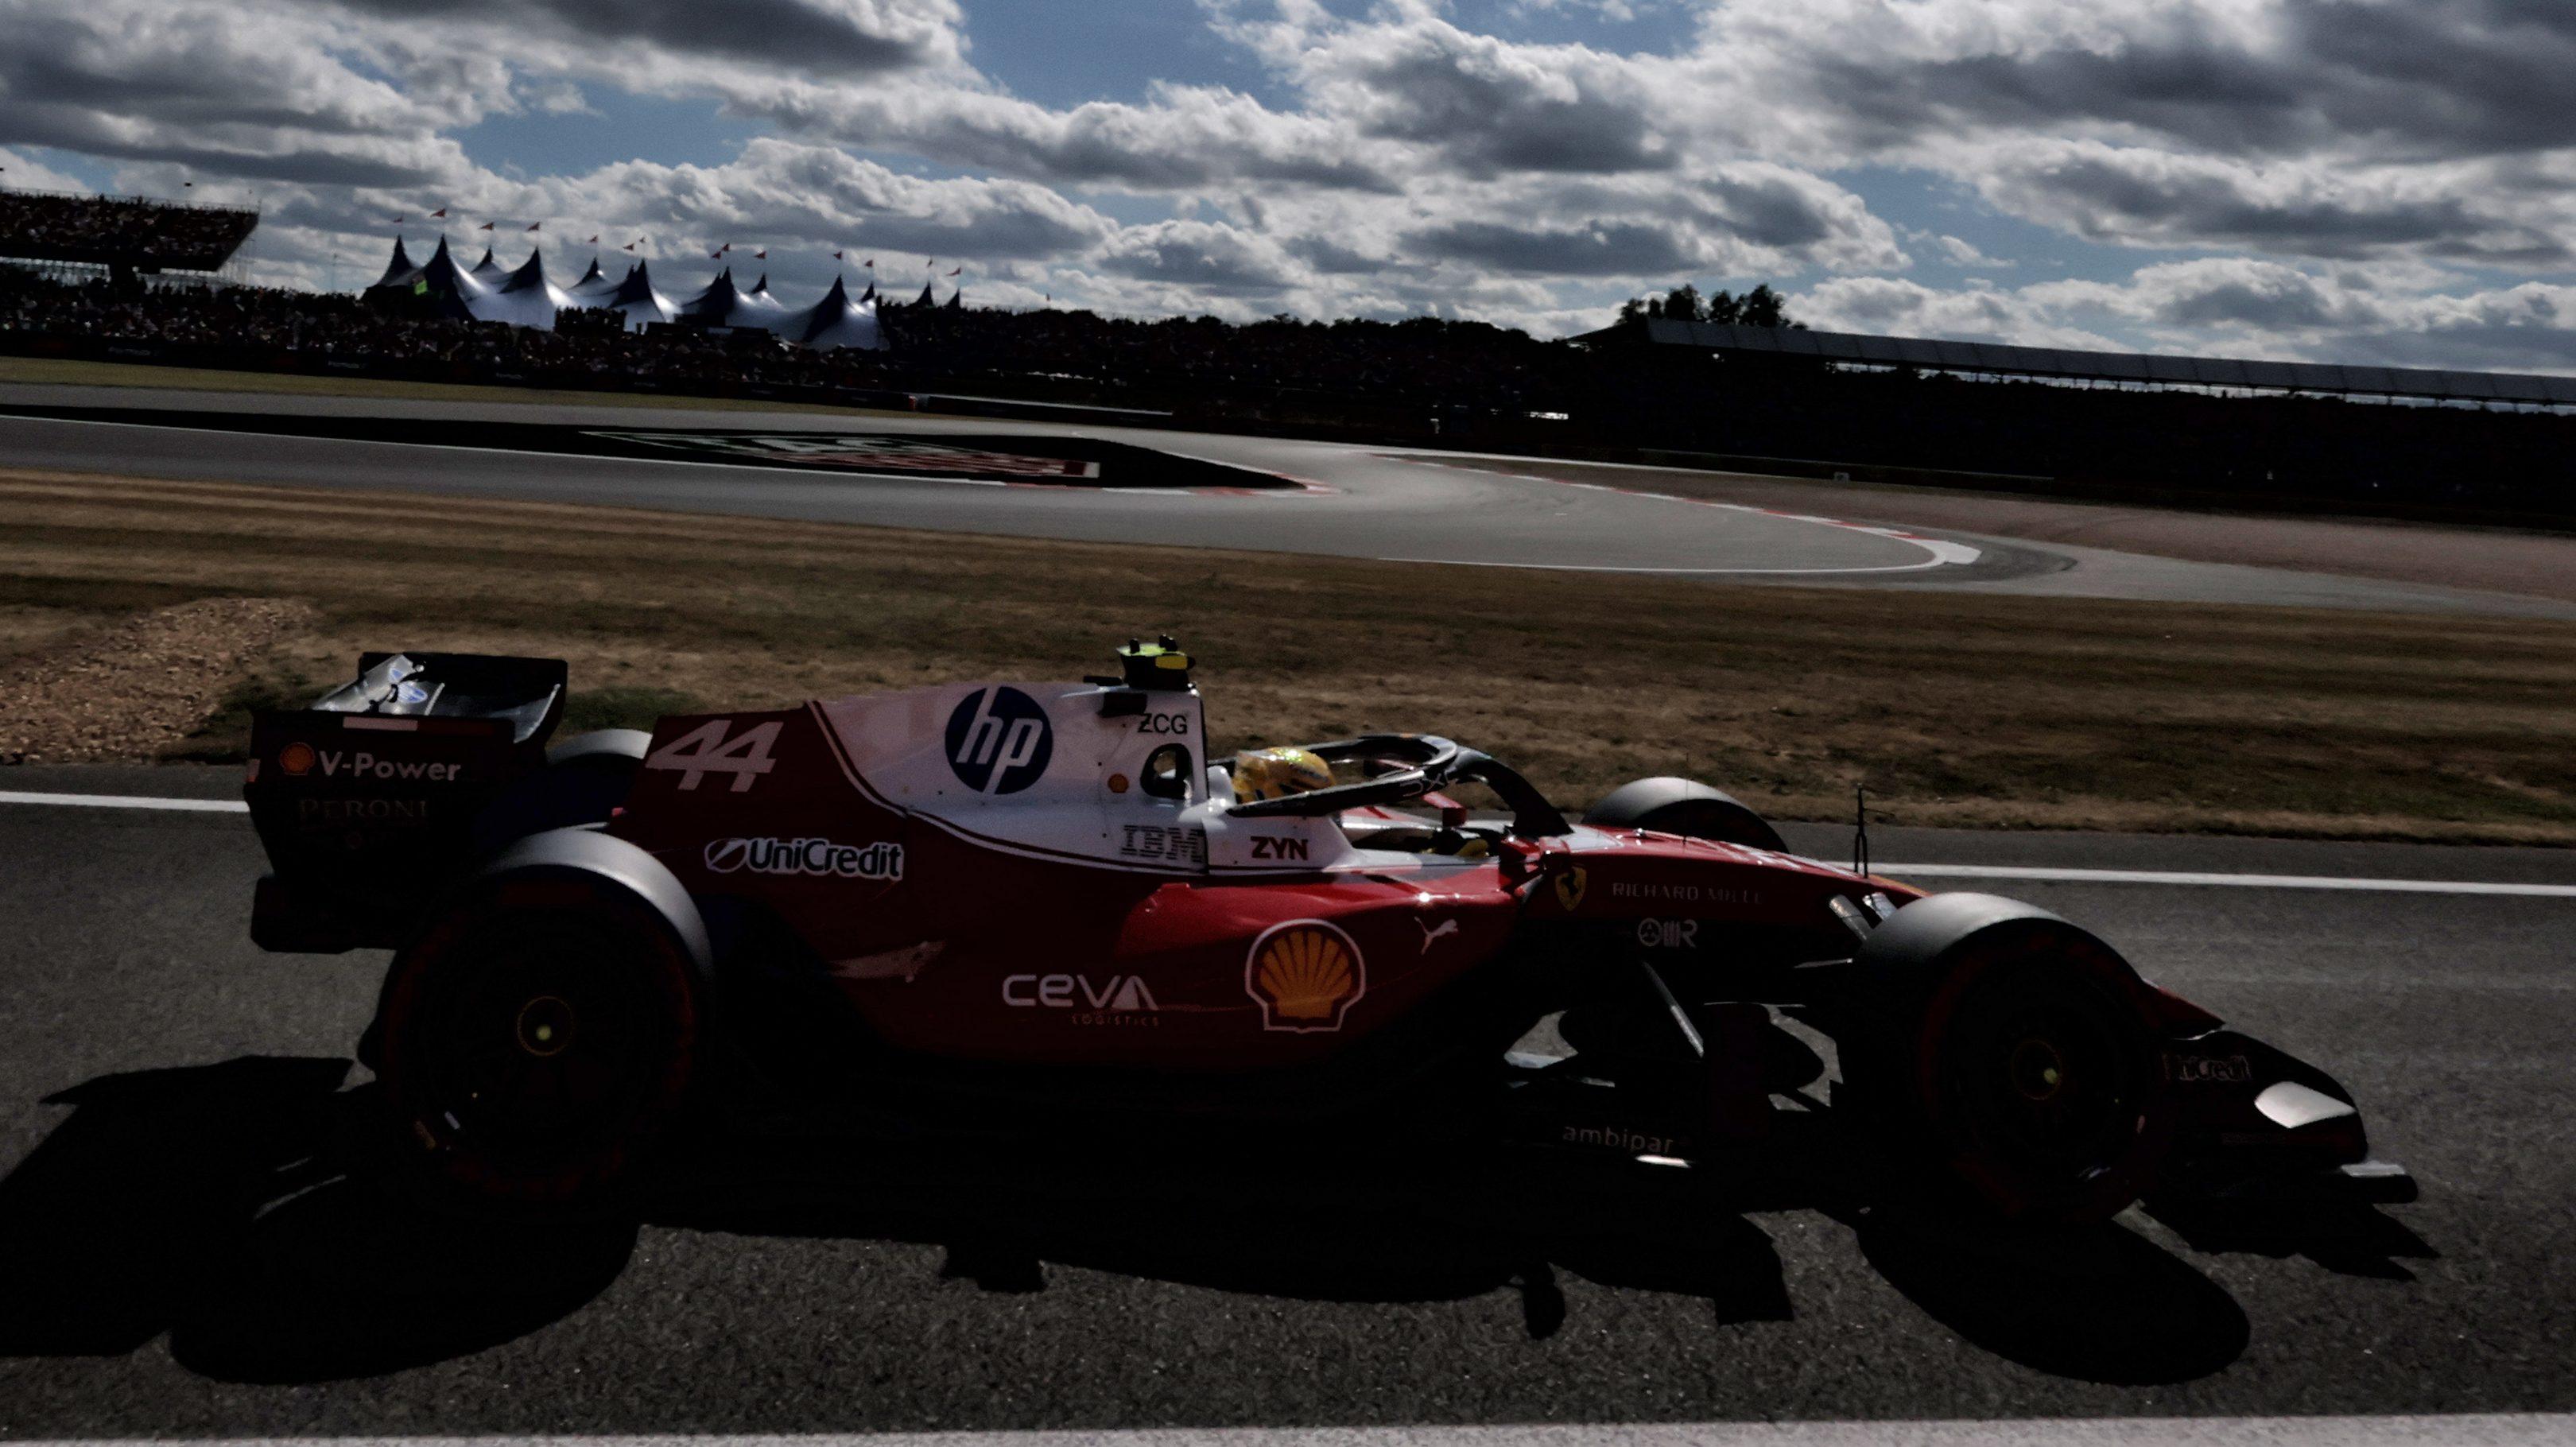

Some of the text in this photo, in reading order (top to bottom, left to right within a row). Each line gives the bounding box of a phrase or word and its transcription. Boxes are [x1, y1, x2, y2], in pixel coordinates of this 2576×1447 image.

[956, 687, 1043, 793] hp
[1139, 715, 1188, 734] ZCG
[319, 750, 462, 782] V-Power
[644, 719, 784, 793] 44
[748, 840, 902, 876] UniCredit
[1121, 824, 1204, 862] IBM
[1250, 836, 1309, 861] ZYN
[1612, 882, 1698, 901] RICHARD
[1562, 1124, 1674, 1154] ambipar
